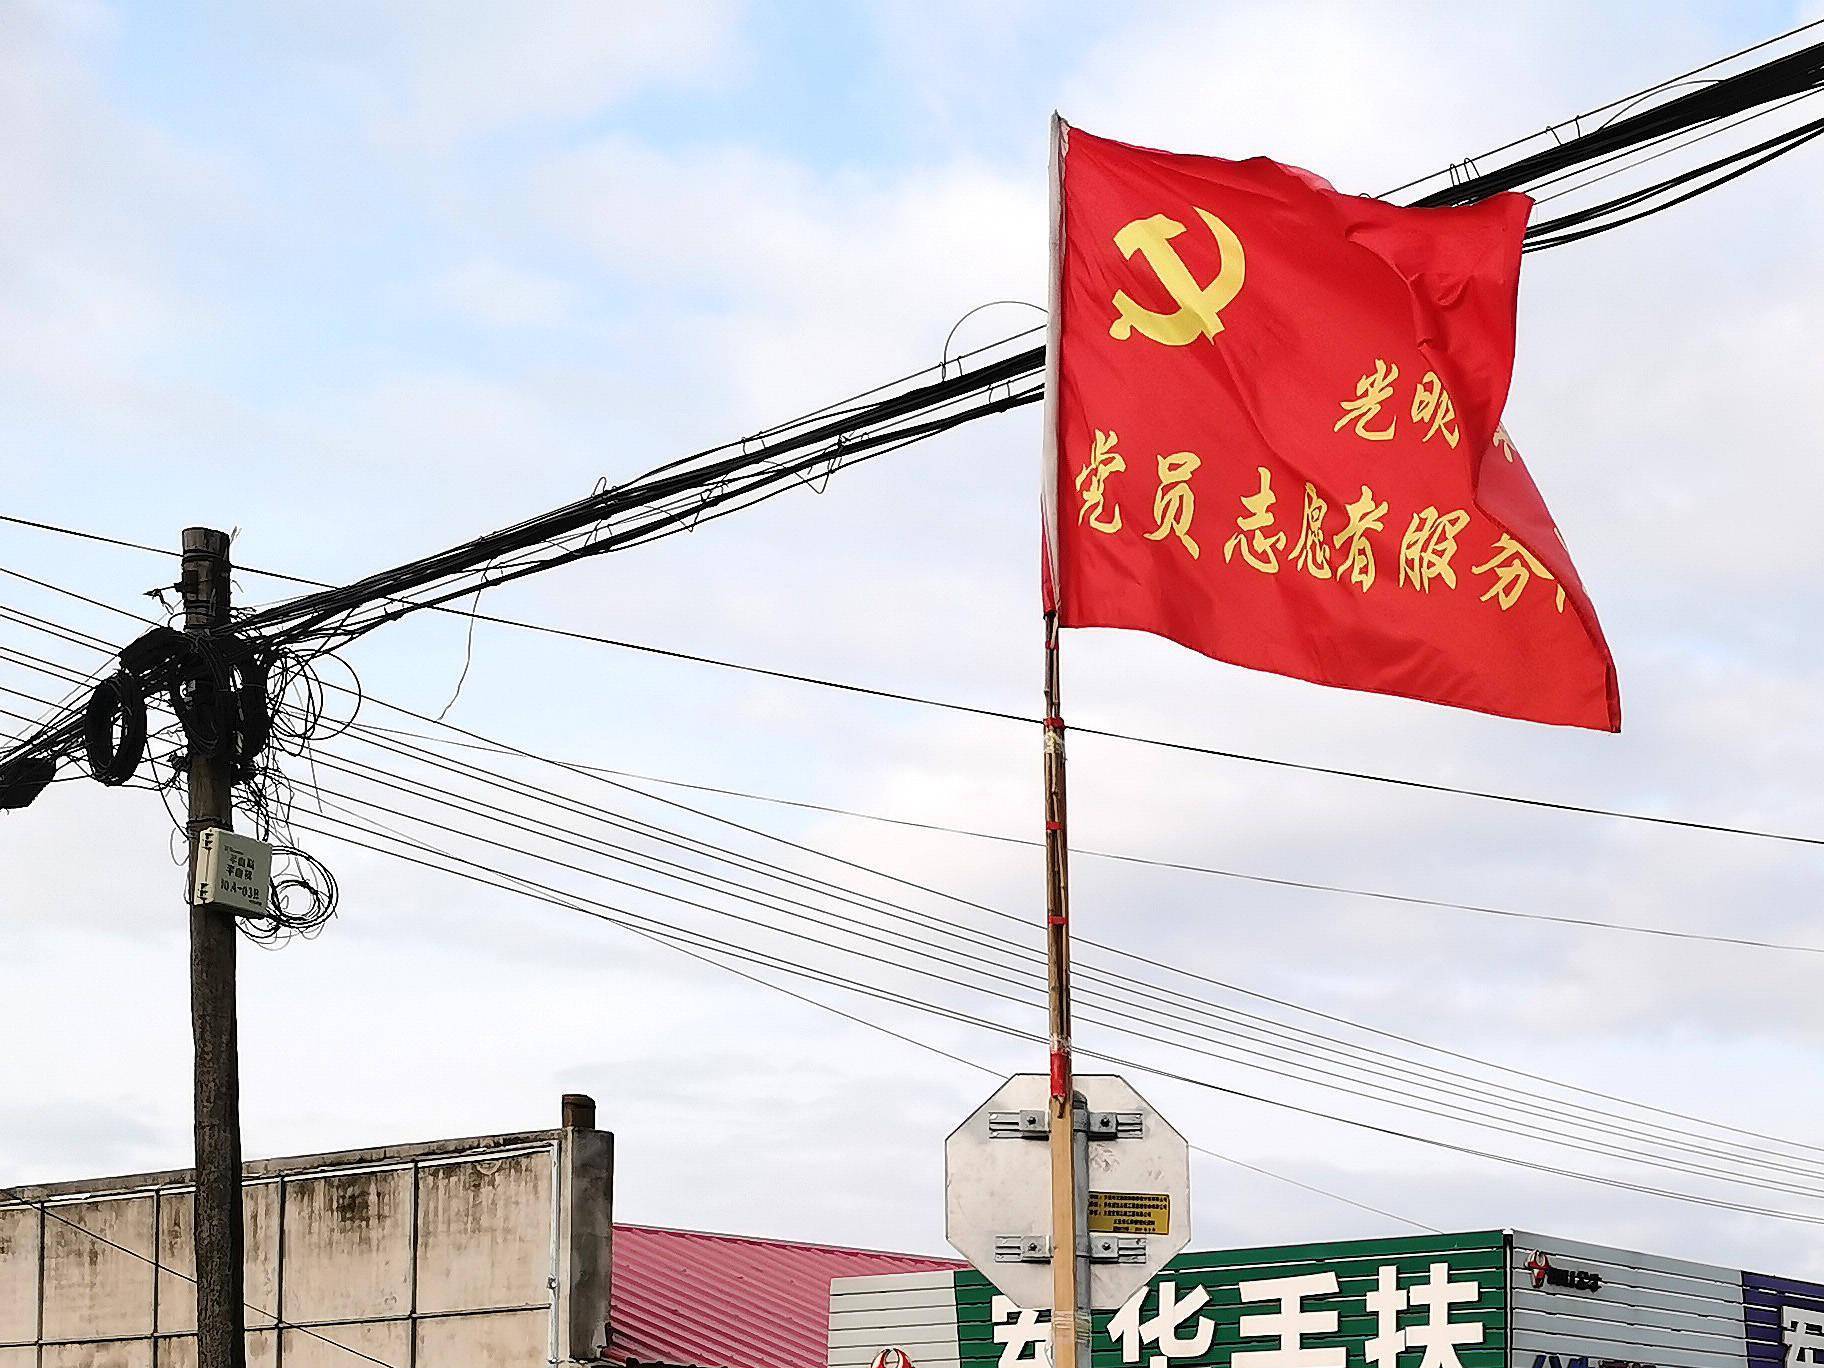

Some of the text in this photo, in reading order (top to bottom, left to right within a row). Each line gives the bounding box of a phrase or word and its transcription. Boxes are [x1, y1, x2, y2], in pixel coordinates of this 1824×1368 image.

[1333, 358, 1515, 463] 光明
[1075, 428, 1568, 616] 党员志愿者服务
